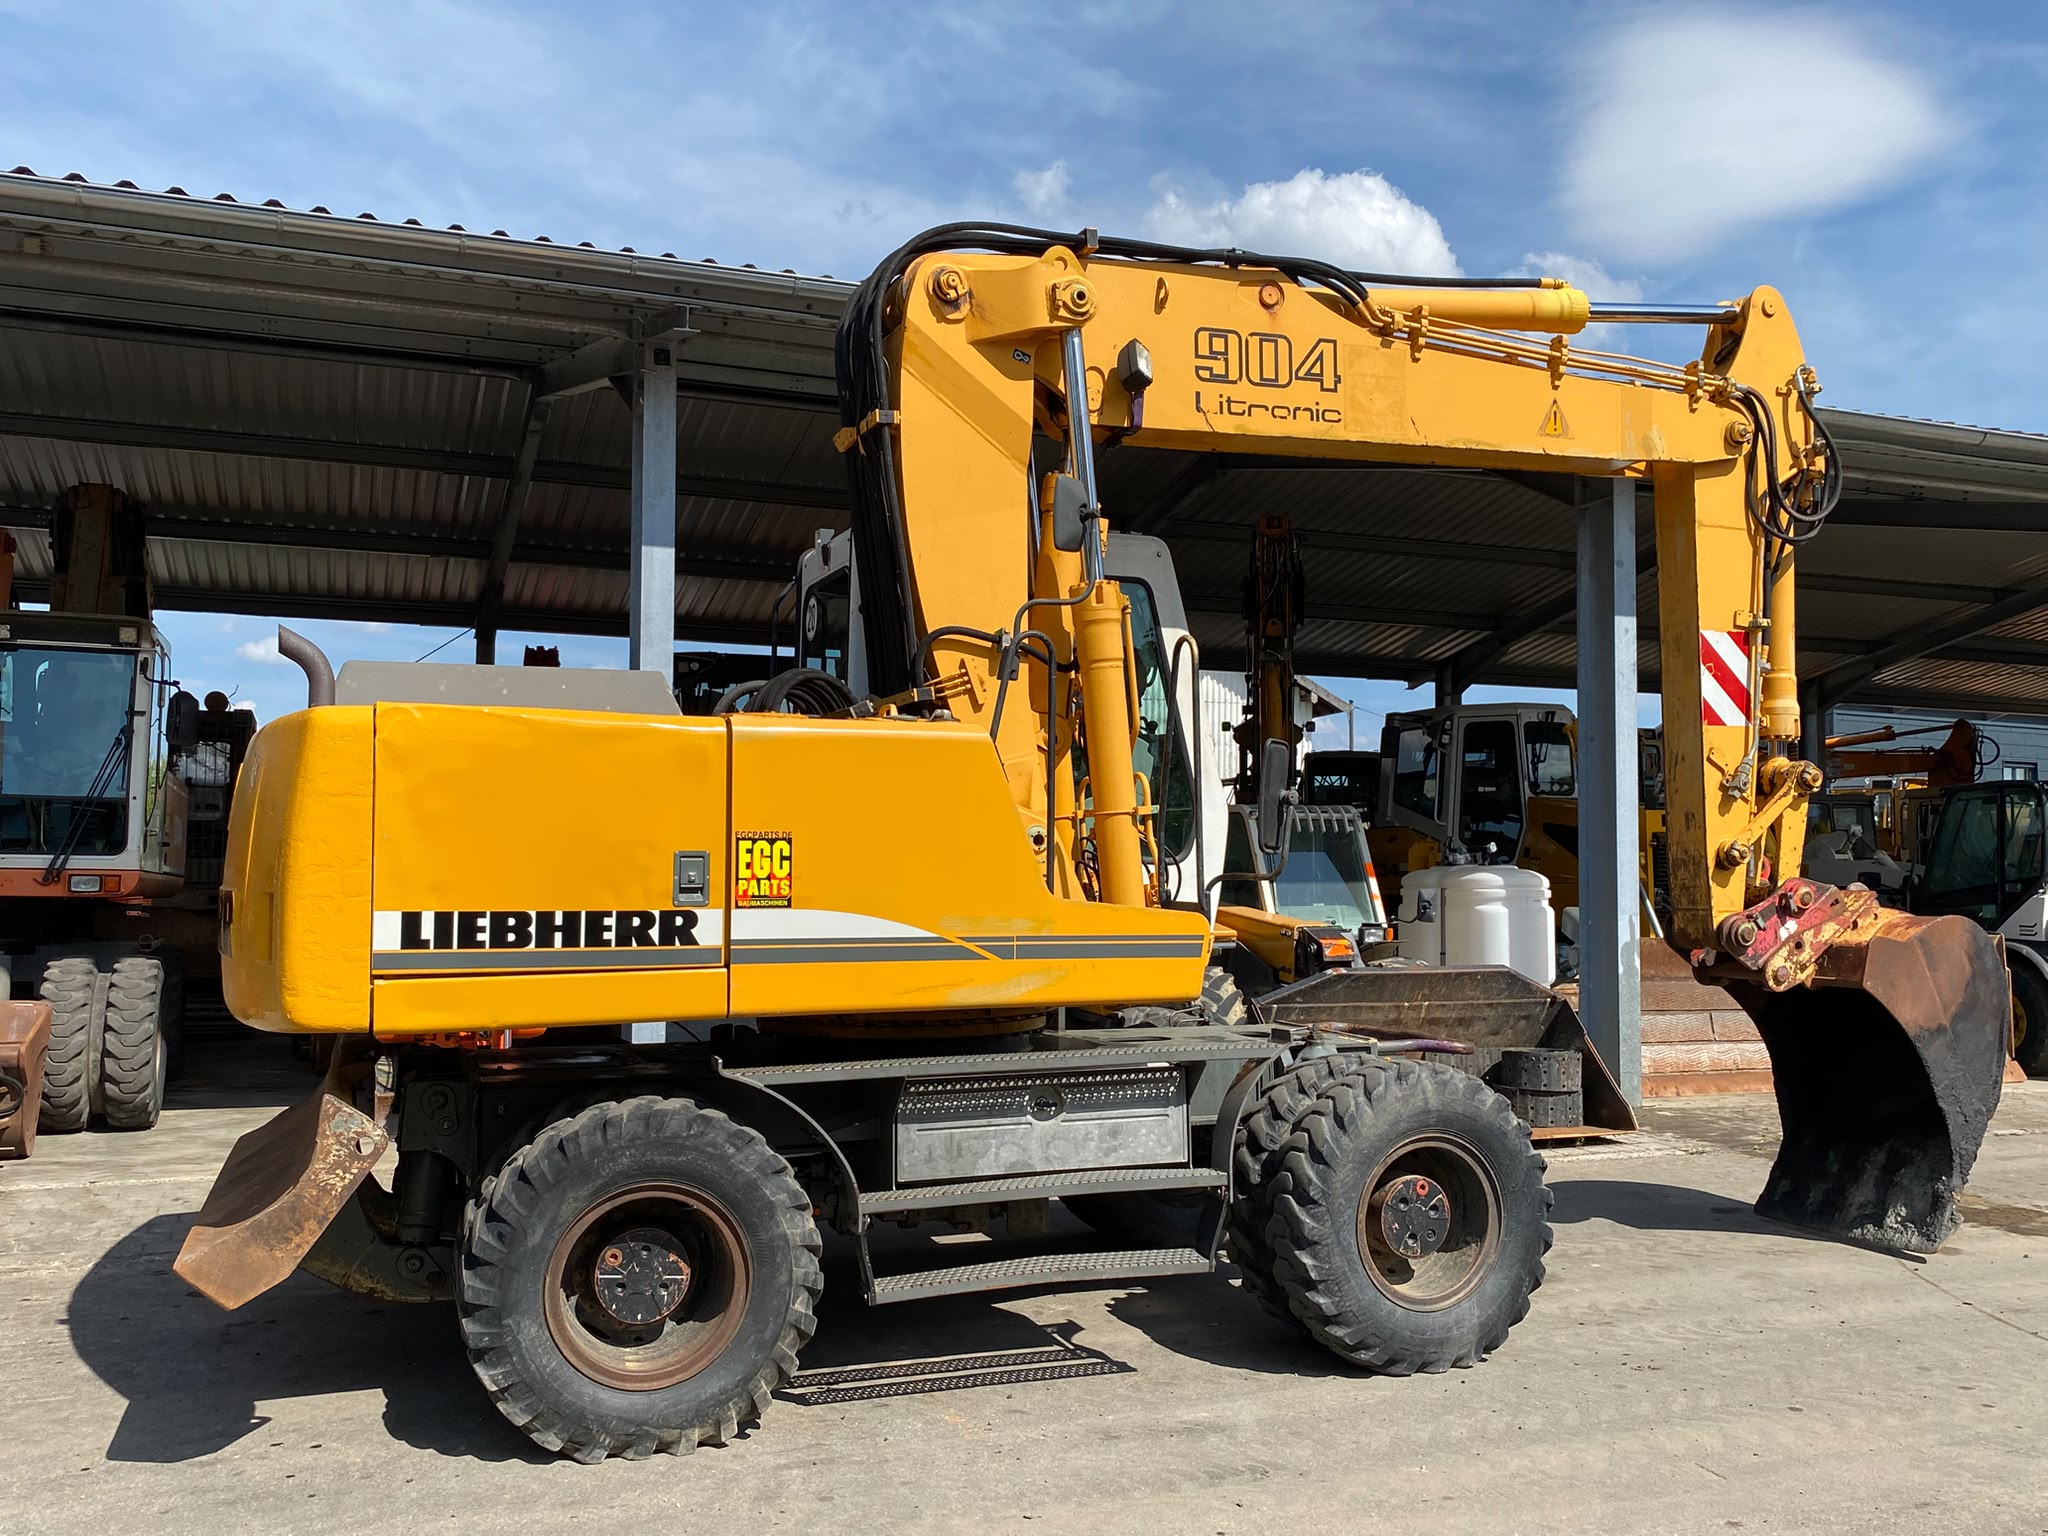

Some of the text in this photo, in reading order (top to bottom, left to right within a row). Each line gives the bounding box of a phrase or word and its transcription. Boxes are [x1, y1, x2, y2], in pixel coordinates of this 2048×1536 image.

[1195, 326, 1341, 393] 904
[1195, 391, 1342, 423] Litronic
[738, 840, 790, 878] EGC
[738, 880, 790, 896] PARTS
[401, 909, 700, 949] LIEBHERR
